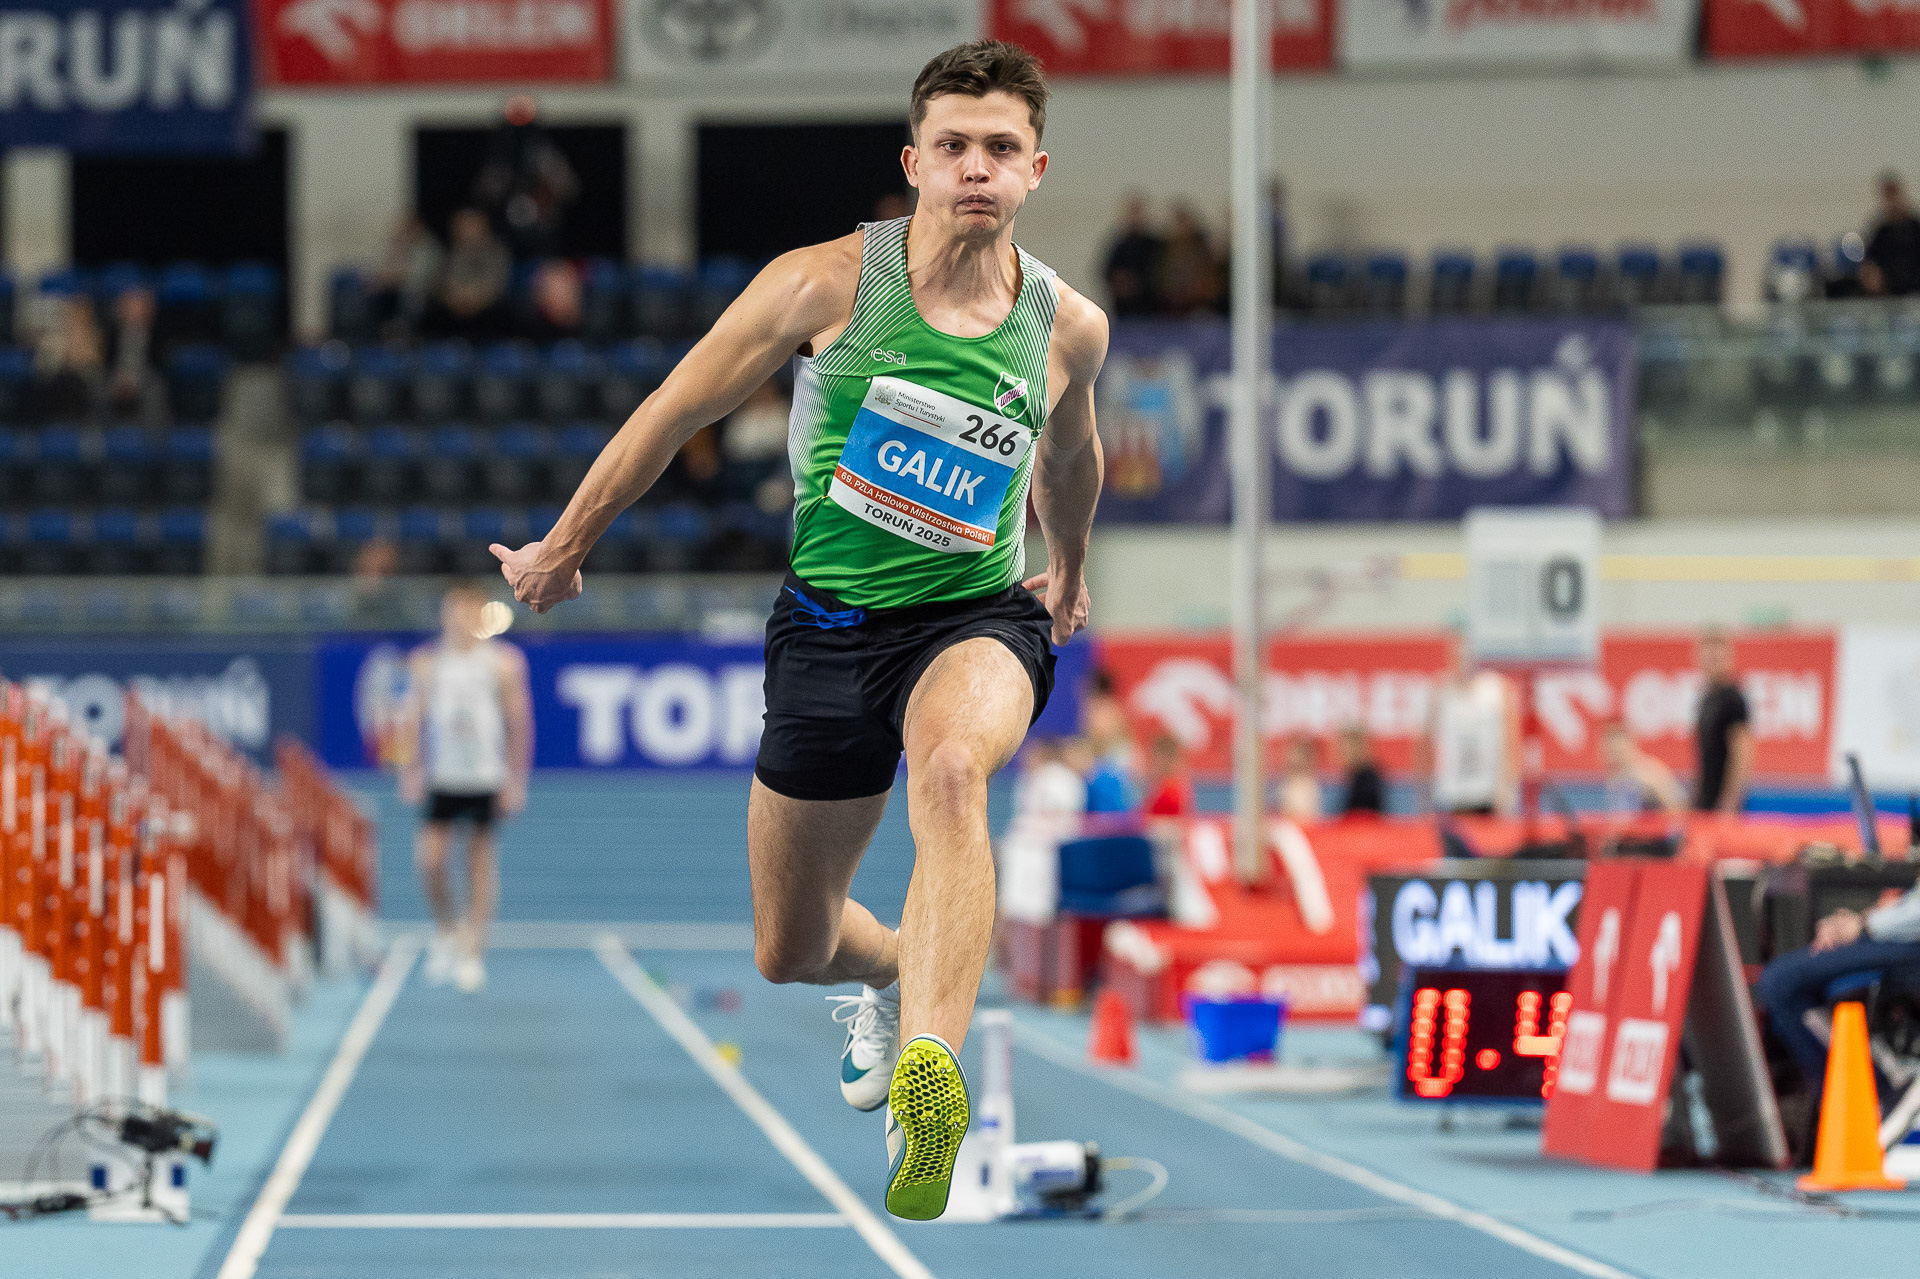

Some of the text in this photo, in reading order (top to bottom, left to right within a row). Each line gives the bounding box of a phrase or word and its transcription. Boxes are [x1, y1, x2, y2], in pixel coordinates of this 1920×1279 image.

[895, 399, 915, 412] Sportu
[919, 408, 946, 423] Turystyki
[898, 392, 936, 410] Ministerstwo
[959, 415, 1020, 457] 266
[877, 439, 986, 506] GALIK
[841, 471, 990, 543] 69. PZLA Halowe Mistrzostwa Polski
[865, 503, 952, 547] TORUŃ 2025
[1538, 553, 1586, 622] 0
[1392, 879, 1582, 967] GALIK
